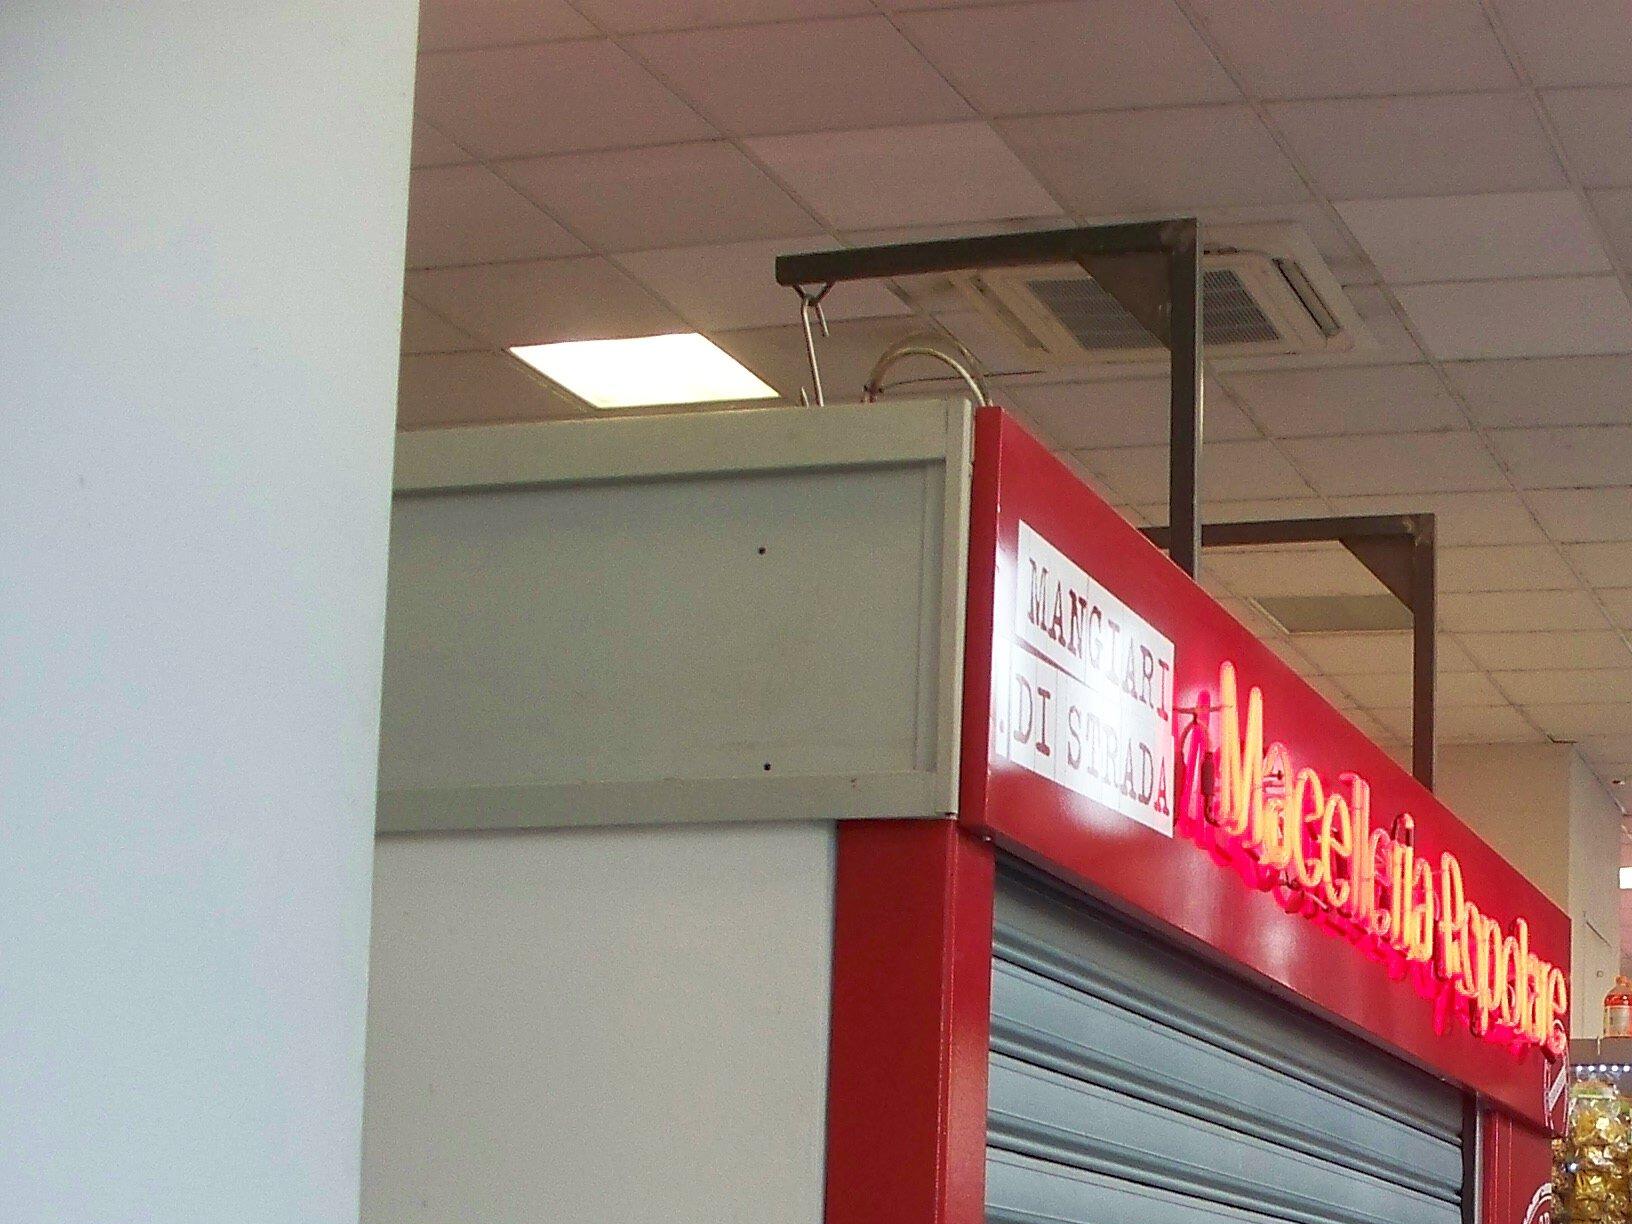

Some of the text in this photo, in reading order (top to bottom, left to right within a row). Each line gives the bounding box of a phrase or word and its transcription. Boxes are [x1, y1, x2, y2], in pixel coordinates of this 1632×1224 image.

[1027, 557, 1170, 722] MANGIARI
[1014, 672, 1171, 817] DI STRADA
[1437, 851, 1568, 1055] Popolare
